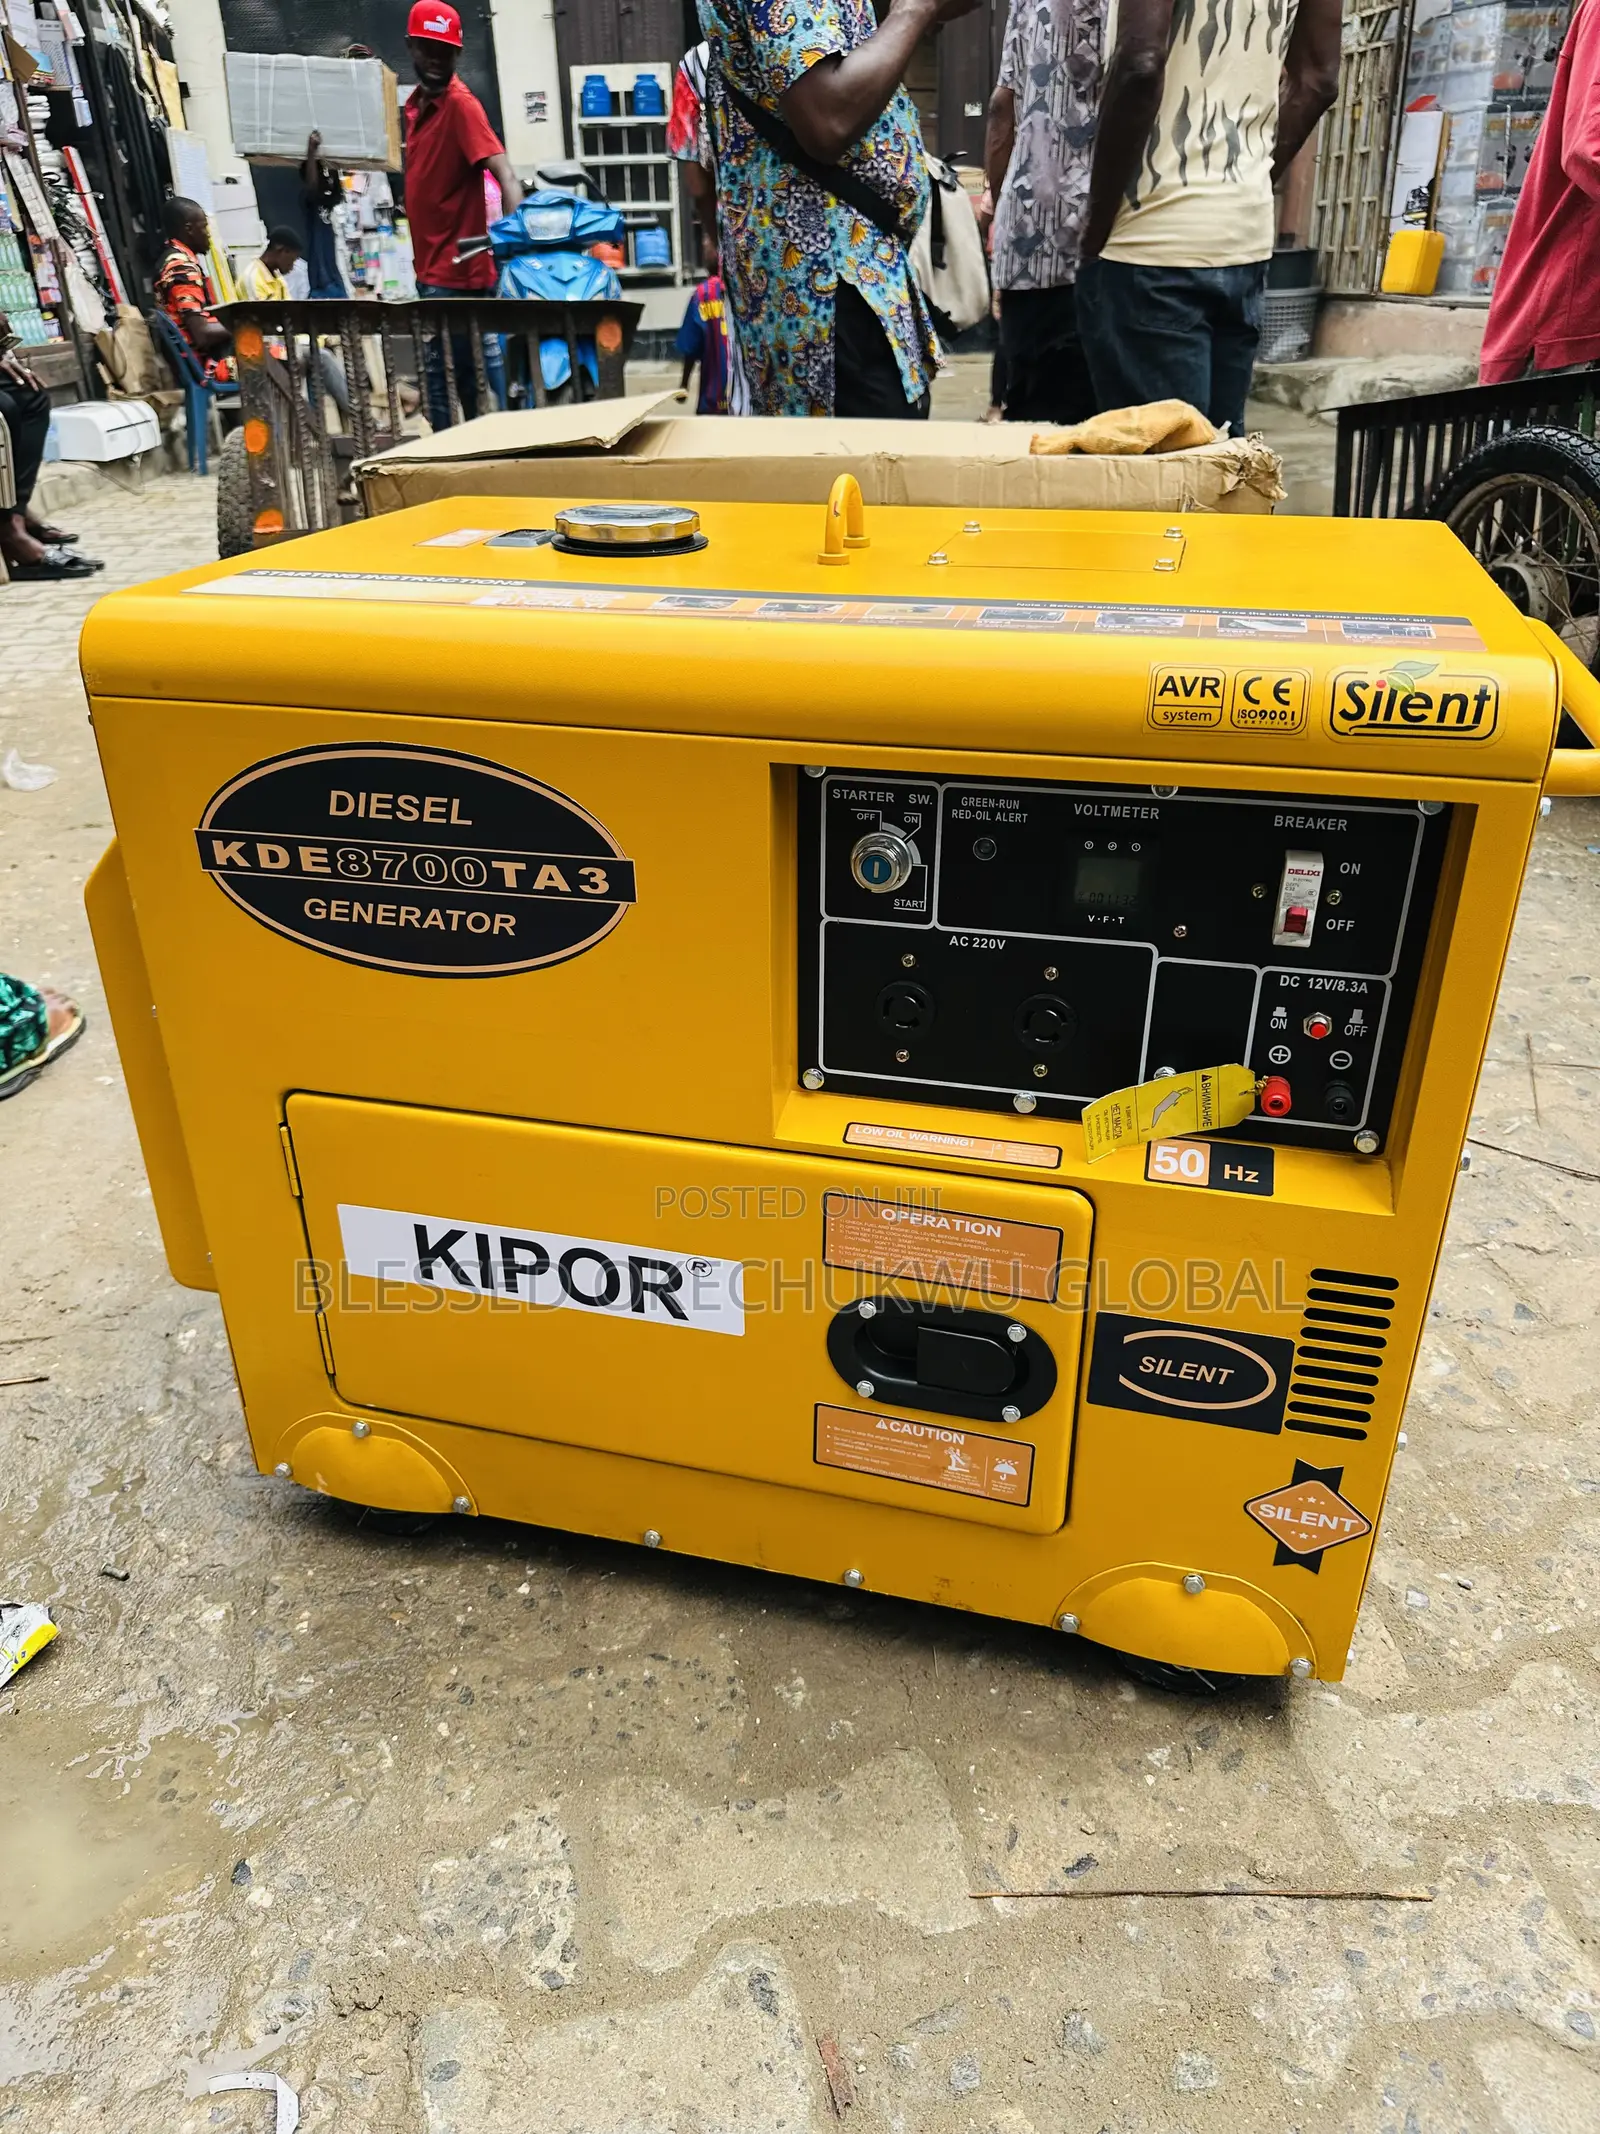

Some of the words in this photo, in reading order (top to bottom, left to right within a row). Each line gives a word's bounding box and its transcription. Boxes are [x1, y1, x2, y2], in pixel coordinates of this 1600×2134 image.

[253, 570, 360, 580] STARTING
[361, 574, 526, 586] INSTRUCTIONS
[1158, 675, 1221, 699] AVR
[1243, 676, 1293, 706] CE
[1339, 679, 1491, 724] Silent
[1163, 710, 1212, 723] system
[1237, 709, 1295, 722] ISO9001
[833, 789, 895, 803] STARTER
[908, 794, 933, 805] SW.
[961, 796, 1020, 810] GREEN-RUN
[329, 789, 473, 826] DIESEL
[1074, 803, 1160, 819] VOLTMETER
[856, 812, 876, 821] OFF
[904, 815, 918, 824] ON
[952, 809, 991, 821] RED-OIL
[995, 812, 1028, 823] ALERT
[1274, 815, 1348, 831] BREAKER
[211, 839, 610, 896] KDE8700TA3
[1287, 868, 1321, 877] DELIXI
[1340, 862, 1361, 875] ON
[894, 899, 924, 909] START
[303, 897, 517, 937] GENERATOR
[1326, 919, 1355, 931] OFF
[949, 935, 969, 947] AC
[972, 937, 1006, 950] 220V
[1280, 975, 1300, 988] DC
[1308, 977, 1368, 994] 12V/8.3A
[1270, 1018, 1288, 1030] ON
[1344, 1024, 1368, 1037] OFF
[1202, 1082, 1213, 1128] ВНИМАНИЕ
[855, 1126, 884, 1136] LOW
[886, 1129, 906, 1139] OIL
[909, 1131, 975, 1148] WARNING!
[1153, 1145, 1205, 1178] 50
[1223, 1164, 1259, 1183] Hz
[881, 1208, 1002, 1238] OPERATION
[1139, 1355, 1235, 1385] SILENT
[889, 1421, 965, 1446] CAUTION
[1258, 1503, 1360, 1532] SILENT
